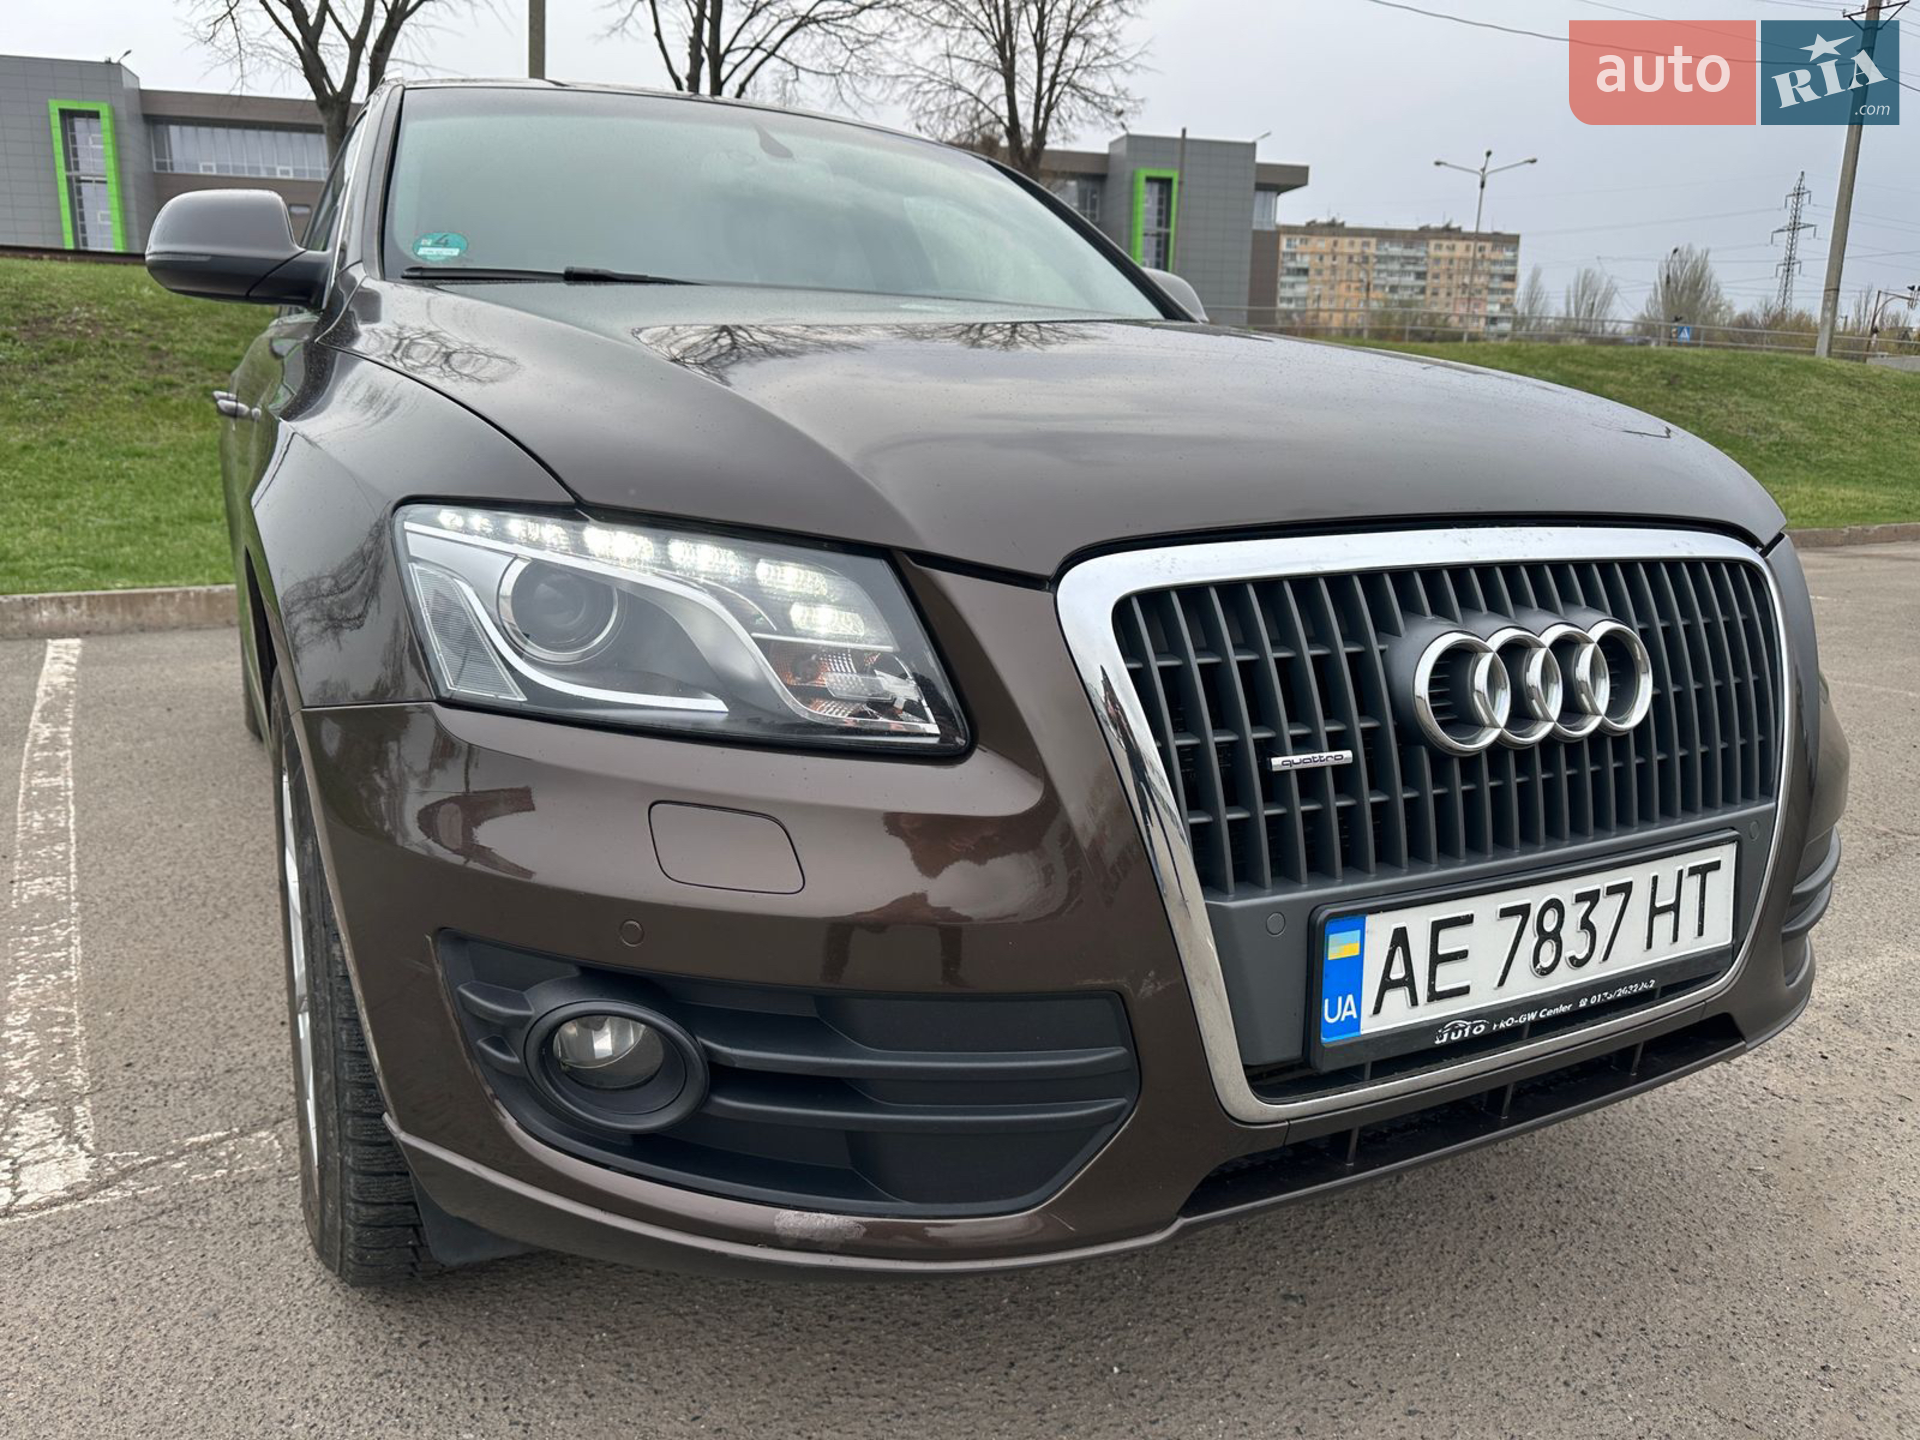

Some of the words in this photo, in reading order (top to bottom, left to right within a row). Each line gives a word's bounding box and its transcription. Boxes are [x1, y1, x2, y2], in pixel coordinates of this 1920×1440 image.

[1281, 754, 1344, 767] quattro
[1371, 913, 1475, 1017] AE
[1493, 880, 1633, 988] 7837
[1645, 859, 1722, 951] HT
[1324, 994, 1358, 1024] UA
[1539, 1003, 1573, 1018] Center
